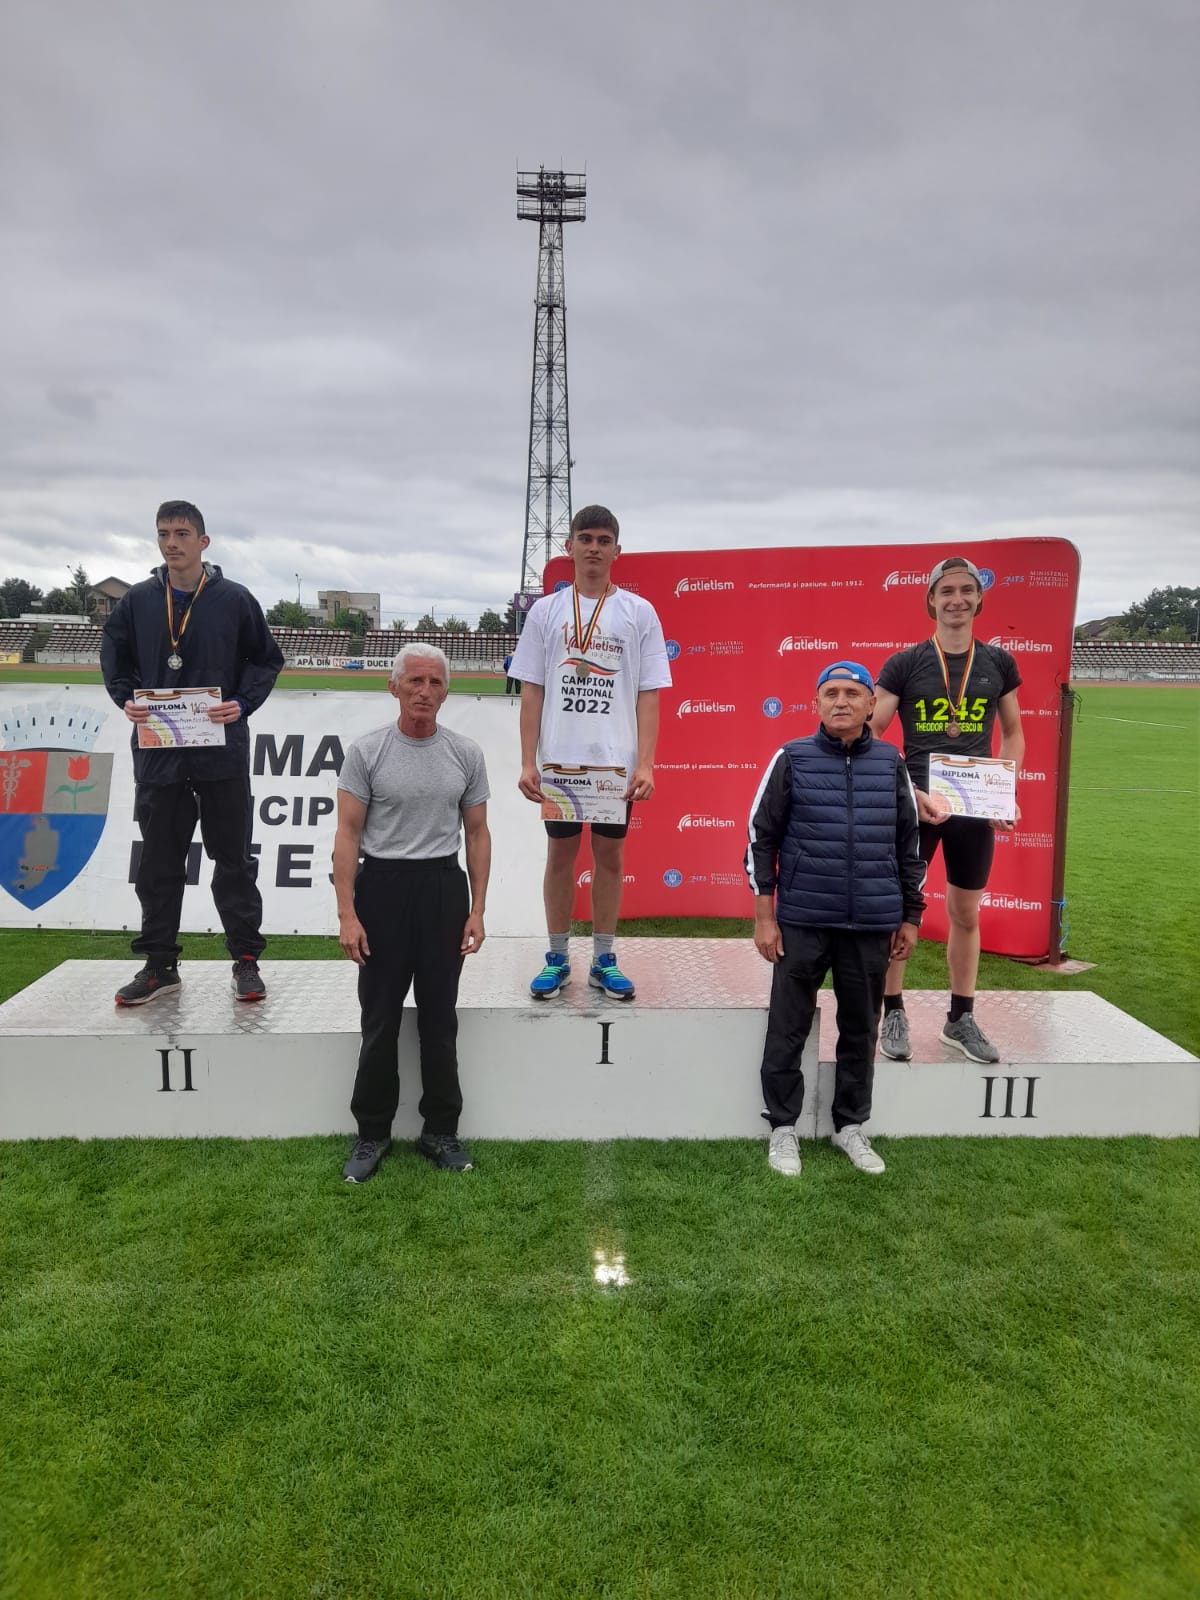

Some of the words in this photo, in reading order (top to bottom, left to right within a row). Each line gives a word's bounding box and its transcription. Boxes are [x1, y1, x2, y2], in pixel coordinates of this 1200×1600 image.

[690, 579, 734, 591] atletism
[900, 573, 930, 585] atleti
[588, 640, 624, 655] tletism
[794, 639, 838, 650] atletism
[1001, 639, 1053, 652] atletism
[316, 658, 331, 666] DIN
[367, 660, 388, 668] DUCE
[562, 675, 614, 688] CAMPION
[561, 686, 614, 699] NATIONAL
[562, 698, 610, 714] 2022
[692, 702, 736, 713] atletism
[915, 697, 988, 721] 1245
[915, 722, 943, 732] THEODOR
[253, 734, 345, 776] MA
[942, 769, 980, 779] DIPLOMĂ
[1018, 769, 1046, 781] tism
[553, 777, 592, 786] DIPLOMĂ
[692, 816, 735, 827] atletism
[992, 897, 1042, 910] atletism
[595, 1022, 615, 1064] I
[155, 1048, 199, 1092] II
[977, 1076, 1042, 1119] III
